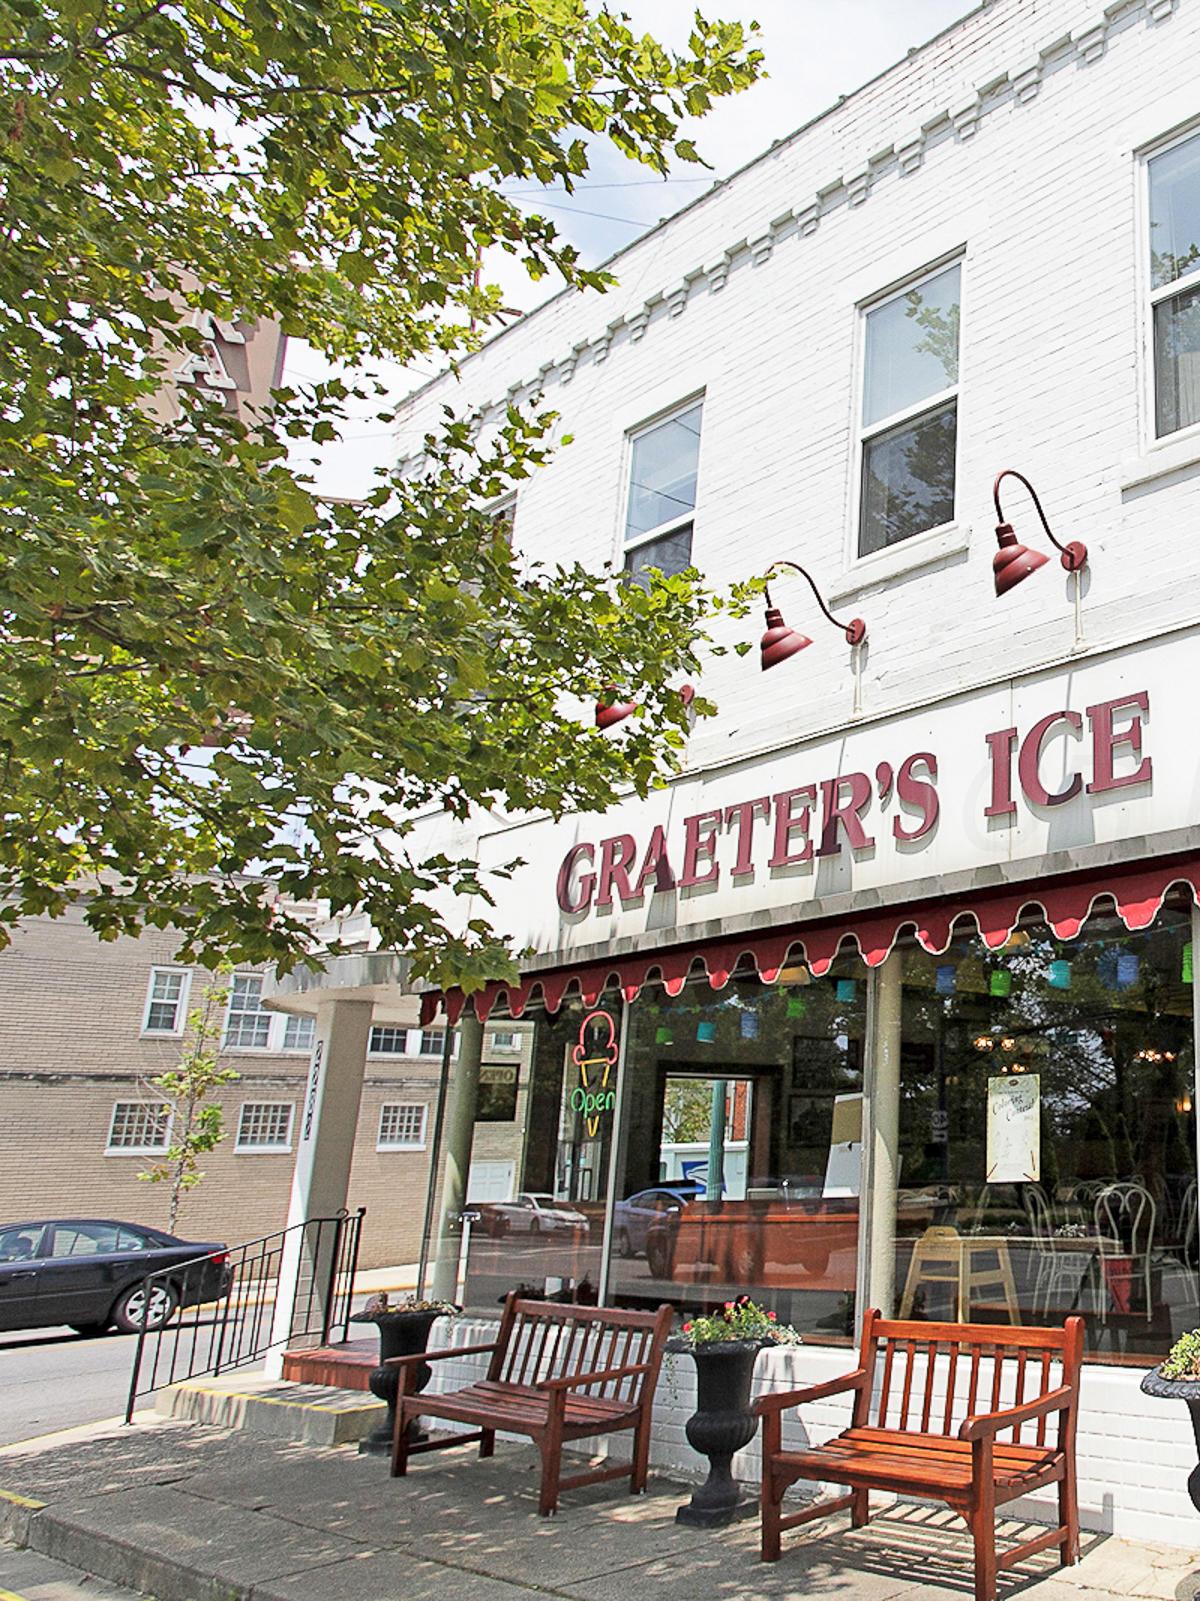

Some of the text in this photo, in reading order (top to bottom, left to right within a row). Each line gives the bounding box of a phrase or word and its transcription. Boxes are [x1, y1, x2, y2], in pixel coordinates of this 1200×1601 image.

[556, 752, 940, 914] GRAETER'S
[984, 690, 1153, 818] ICE
[570, 1088, 616, 1119] Open
